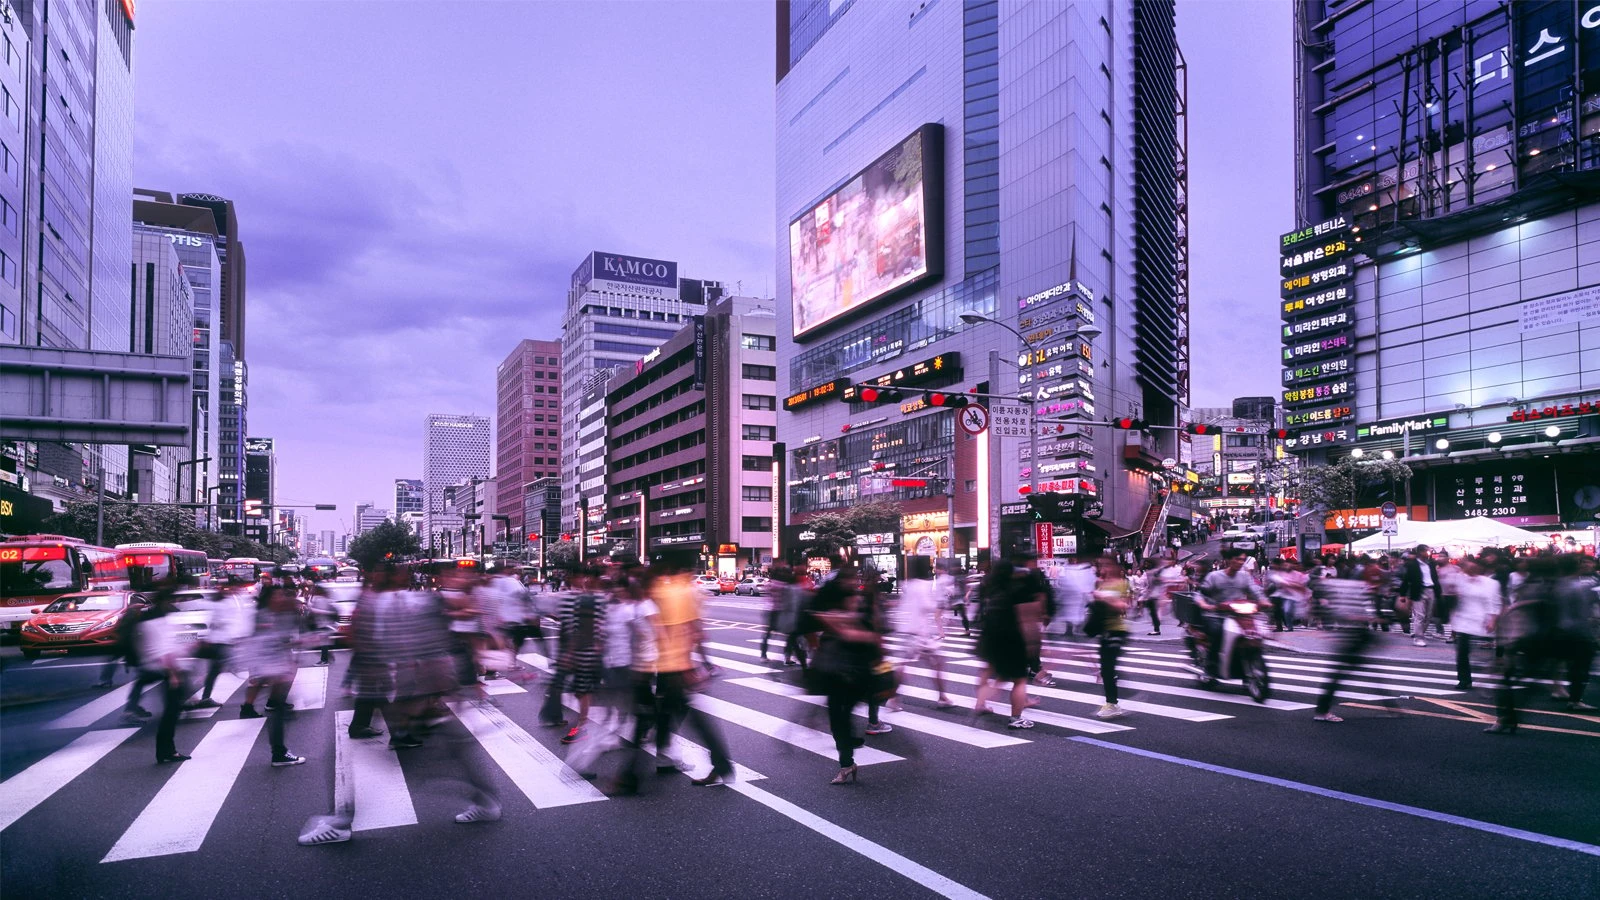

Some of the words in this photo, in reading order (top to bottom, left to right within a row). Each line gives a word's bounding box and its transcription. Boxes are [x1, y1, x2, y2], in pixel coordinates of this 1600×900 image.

[604, 257, 668, 278] KAMCO
[1311, 264, 1347, 283] 성형외과
[1305, 287, 1346, 306] 여성의원
[1295, 342, 1320, 355] 미라인
[1370, 419, 1432, 436] FamilyMart
[1465, 508, 1488, 517] 3482
[1492, 507, 1516, 516] 2300
[1, 550, 18, 560] 02
